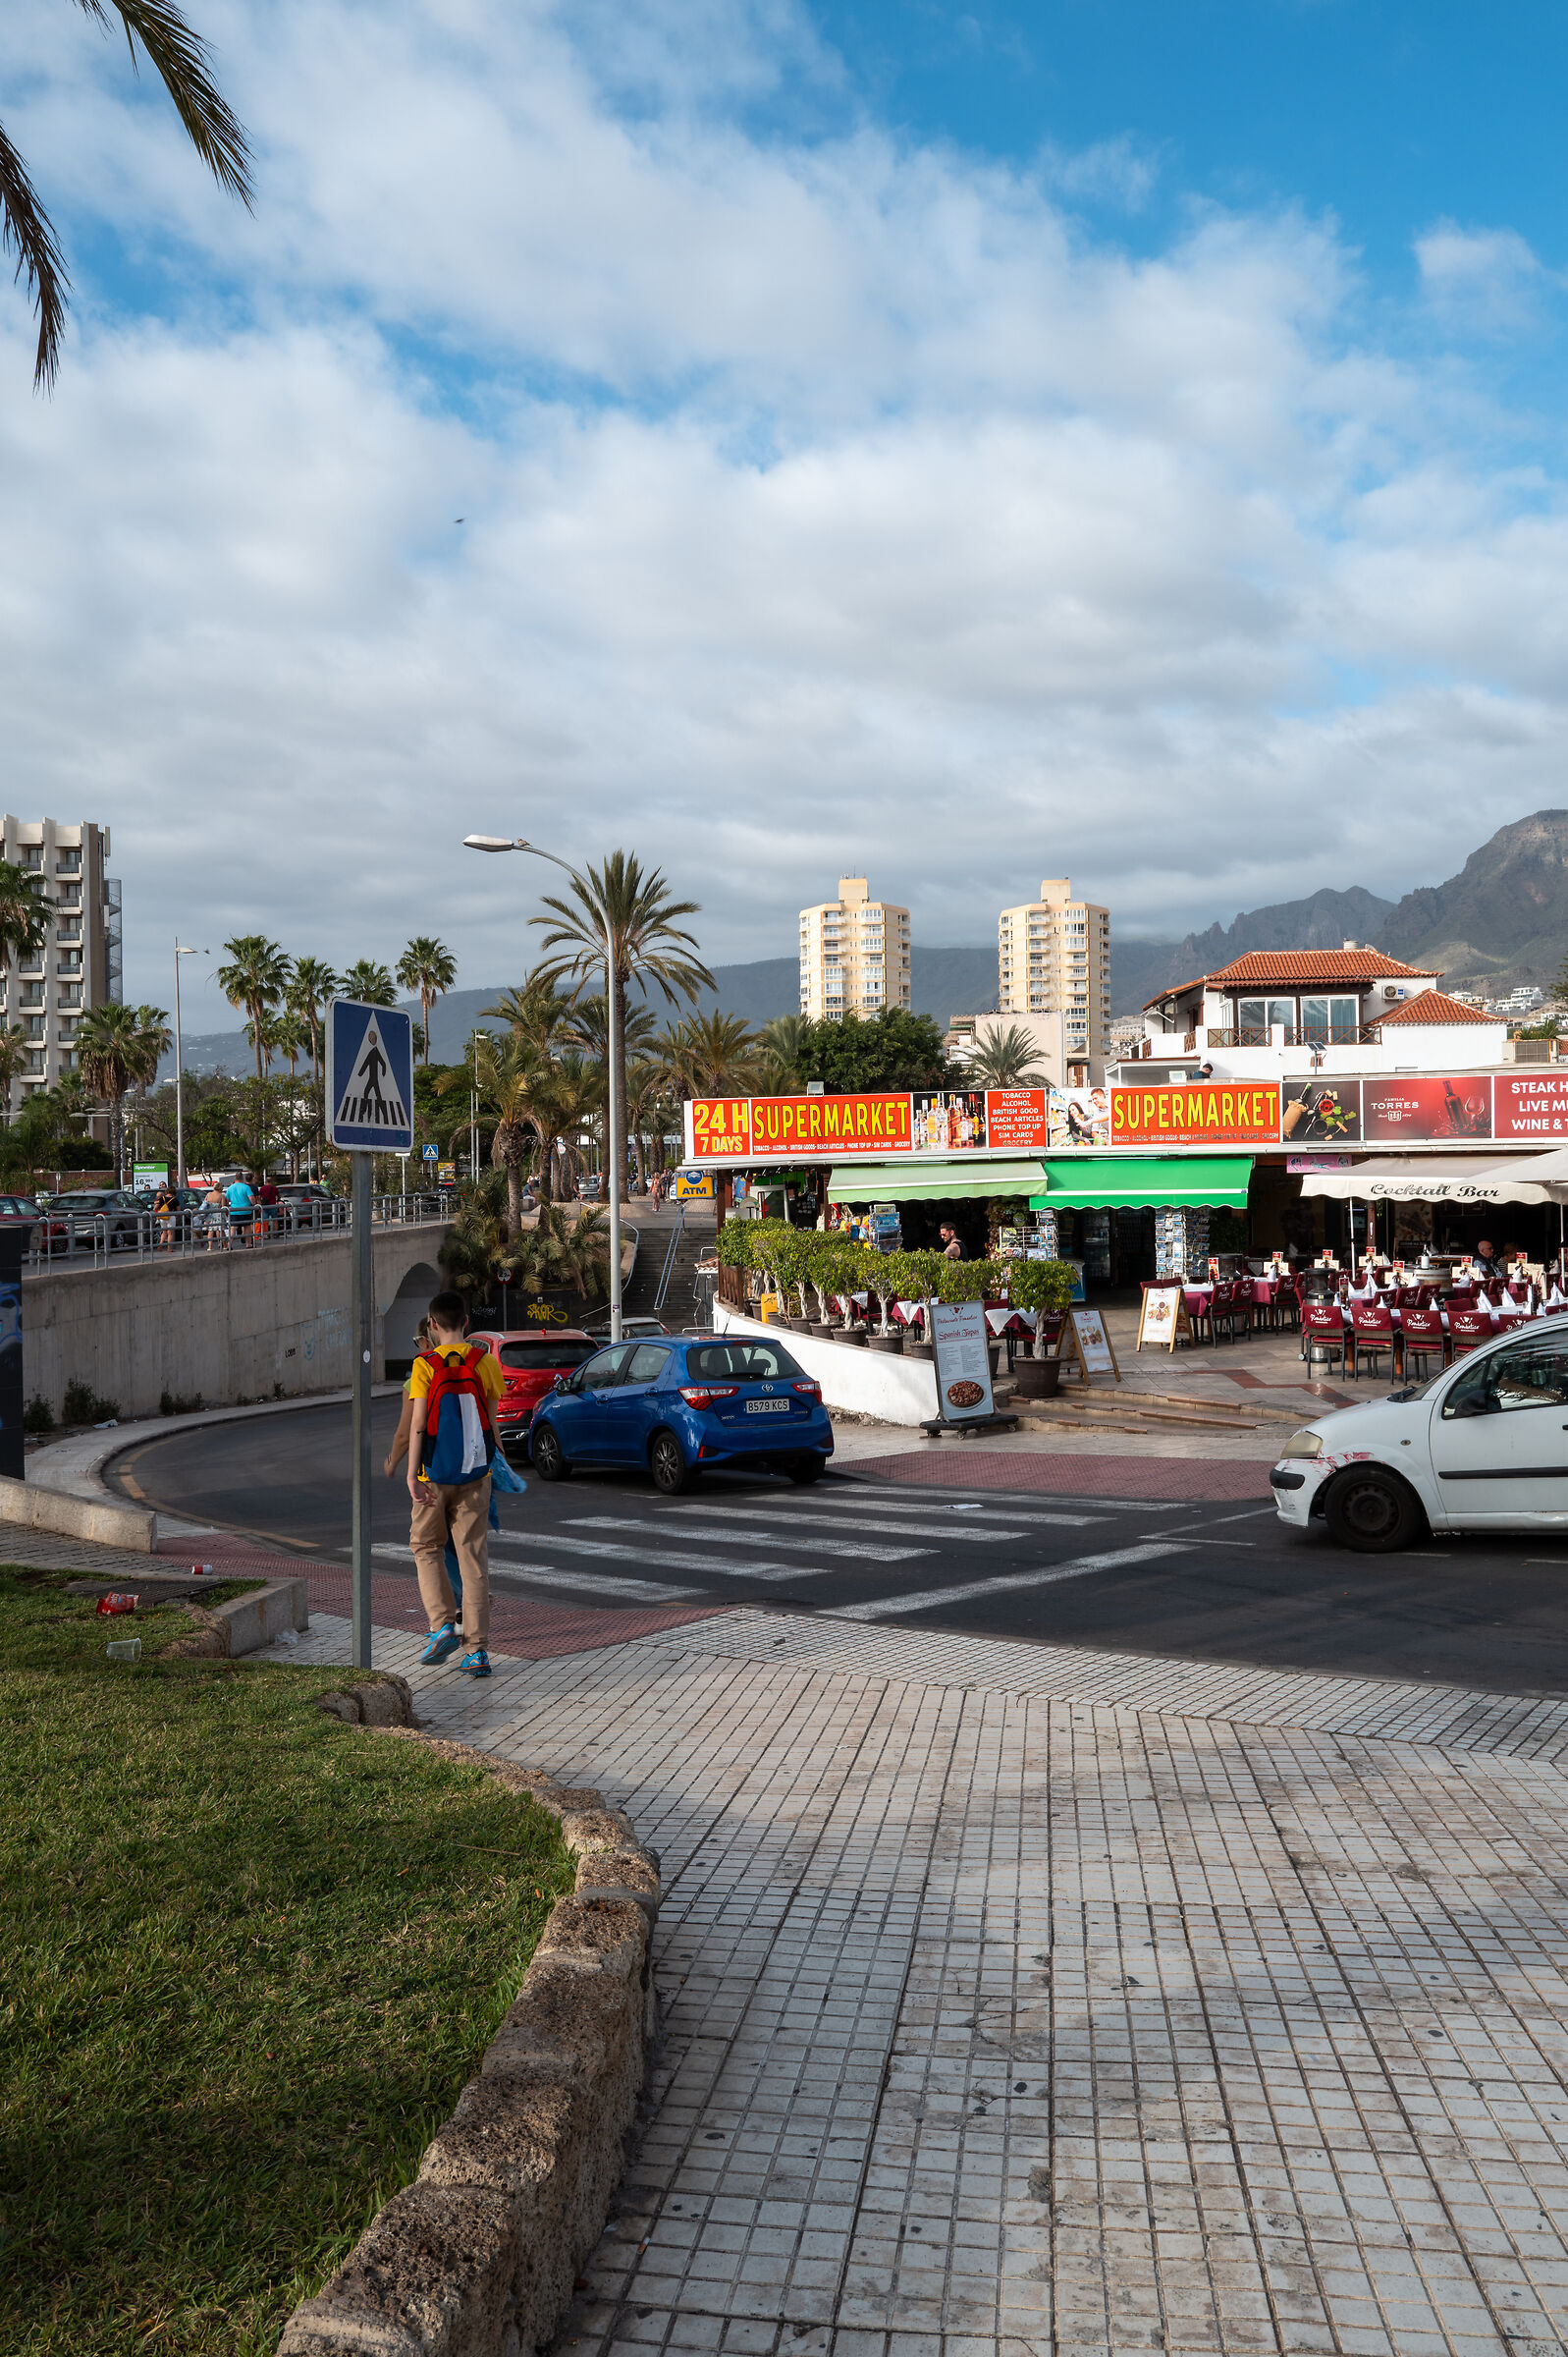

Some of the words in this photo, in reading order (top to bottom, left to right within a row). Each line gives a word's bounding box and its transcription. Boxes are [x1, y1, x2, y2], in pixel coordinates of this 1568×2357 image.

[1511, 1081, 1556, 1094] STEAK
[1113, 1091, 1277, 1129] SUPERMARKET
[1371, 1101, 1419, 1110] TORRES
[1519, 1100, 1549, 1112] LIVE
[1552, 1099, 1568, 1112] M
[694, 1104, 726, 1134] 24
[732, 1103, 748, 1133] H
[754, 1101, 908, 1140] SUPERMARKET
[1511, 1119, 1549, 1130] WINE
[1552, 1118, 1563, 1130] &
[700, 1136, 708, 1153] 7
[712, 1135, 743, 1152] DAYS
[1371, 1183, 1451, 1196] Cocktail
[1456, 1185, 1500, 1198] Bar
[748, 1400, 770, 1412] 8579
[772, 1399, 788, 1410] KCS
